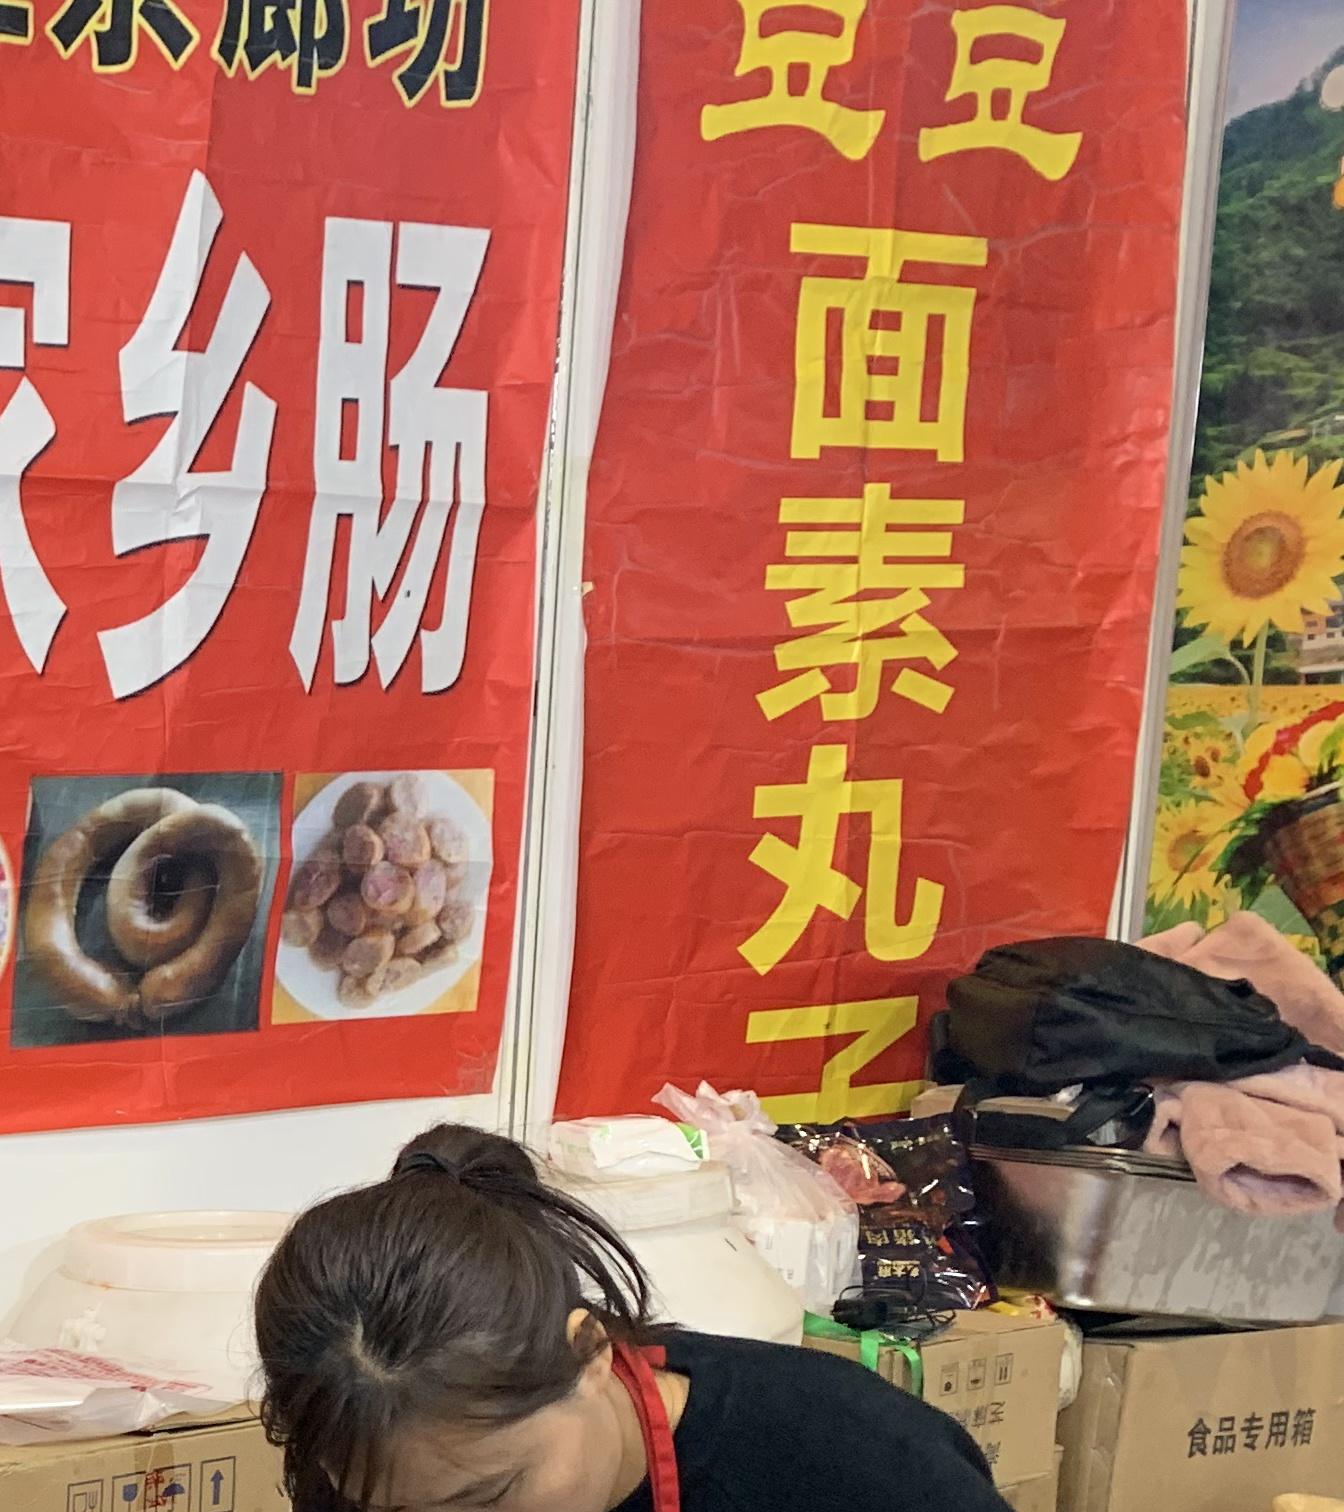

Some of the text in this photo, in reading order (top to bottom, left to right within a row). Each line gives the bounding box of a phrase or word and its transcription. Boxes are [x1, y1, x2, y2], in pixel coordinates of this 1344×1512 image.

[737, 221, 988, 1127] 面素丸子
[1187, 1407, 1316, 1458] 食品专用箱
